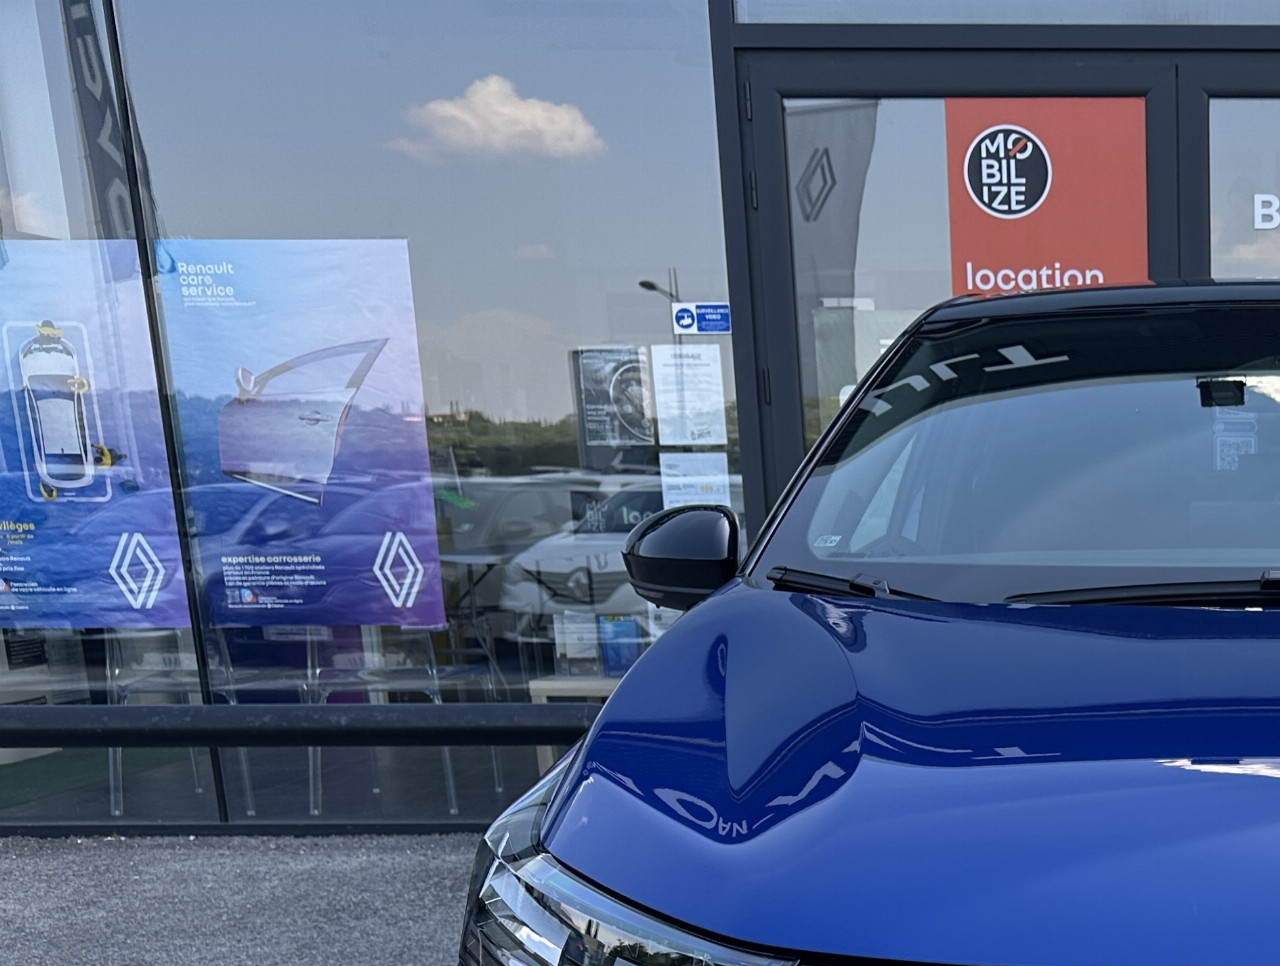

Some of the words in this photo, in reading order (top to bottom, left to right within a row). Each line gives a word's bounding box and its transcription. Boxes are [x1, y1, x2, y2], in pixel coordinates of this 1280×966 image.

[177, 262, 234, 274] Renault
[180, 275, 212, 285] care
[966, 261, 1104, 290] location
[182, 284, 234, 296] service
[221, 554, 266, 565] expertise
[267, 554, 321, 563] carrosserie
